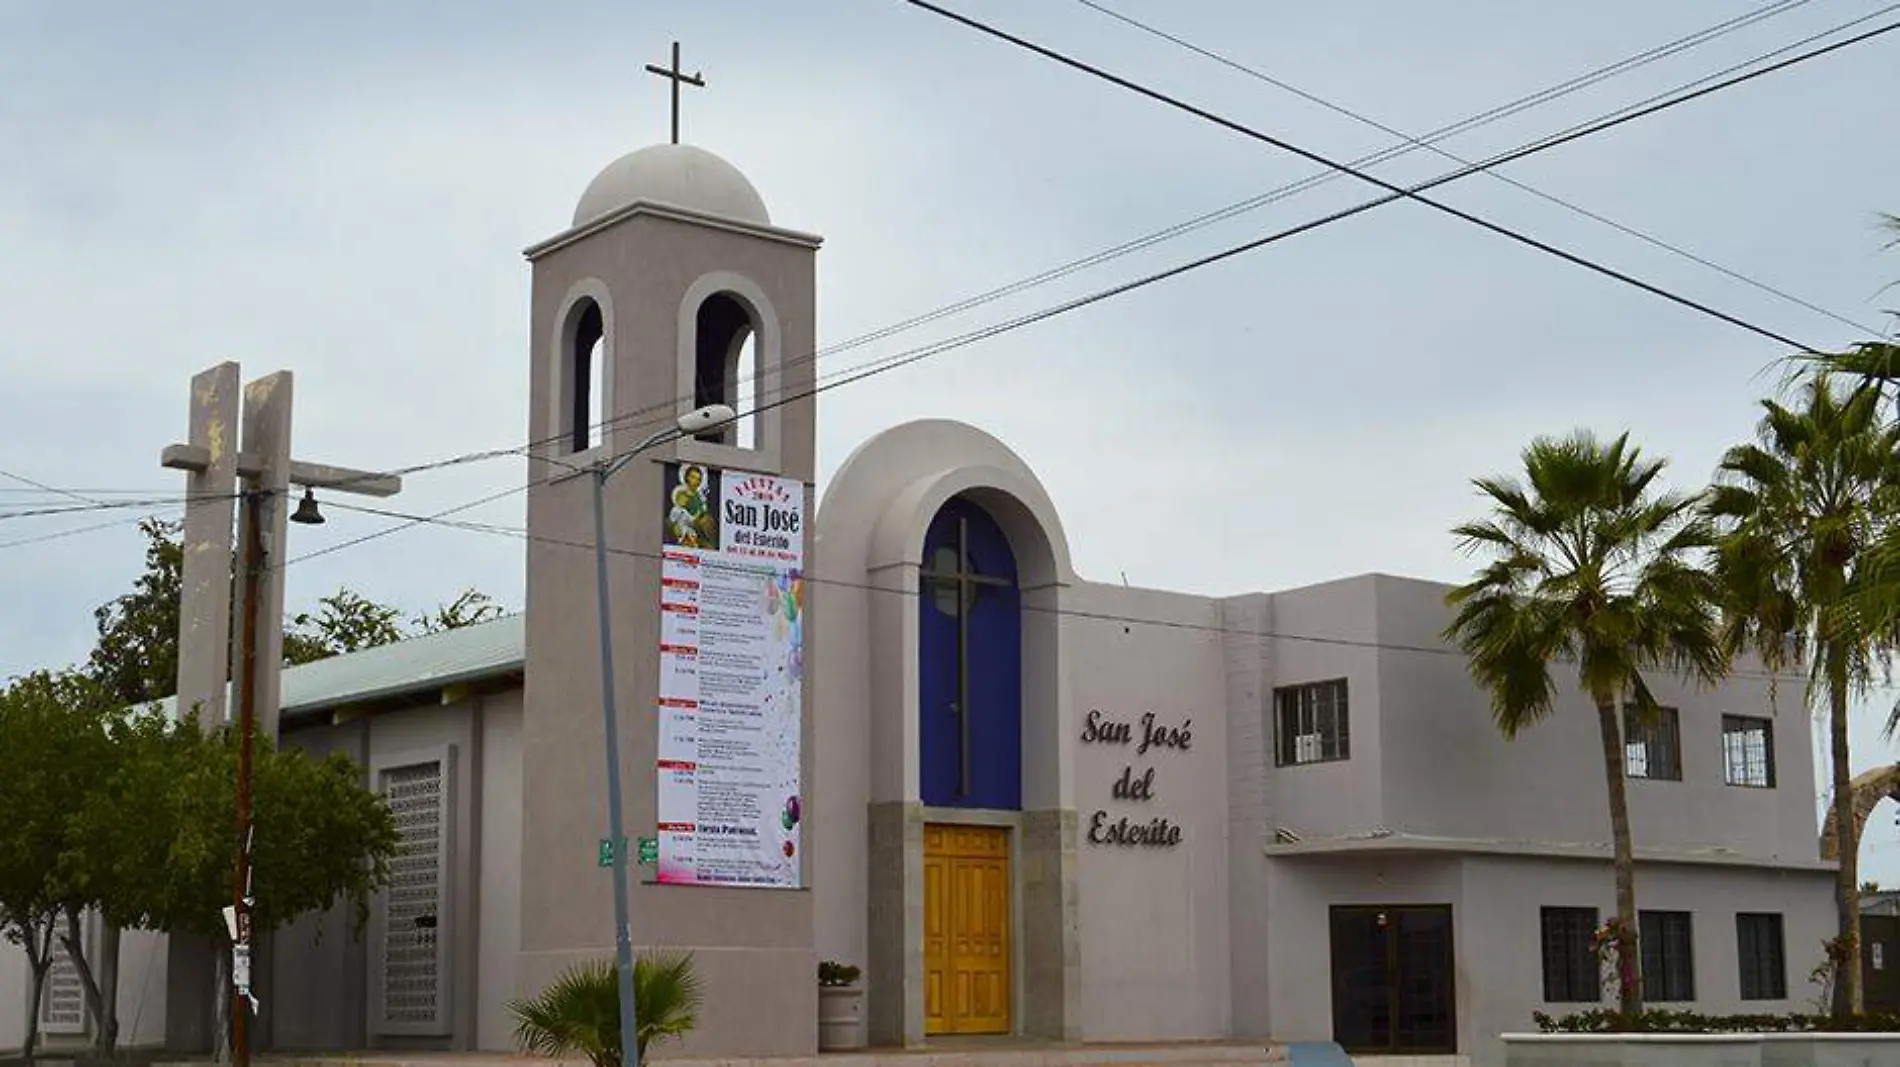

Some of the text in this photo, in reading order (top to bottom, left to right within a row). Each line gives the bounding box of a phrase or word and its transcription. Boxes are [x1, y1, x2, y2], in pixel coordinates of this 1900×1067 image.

[725, 499, 799, 533] San José
[1081, 709, 1192, 755] San José
[1112, 765, 1155, 800] del
